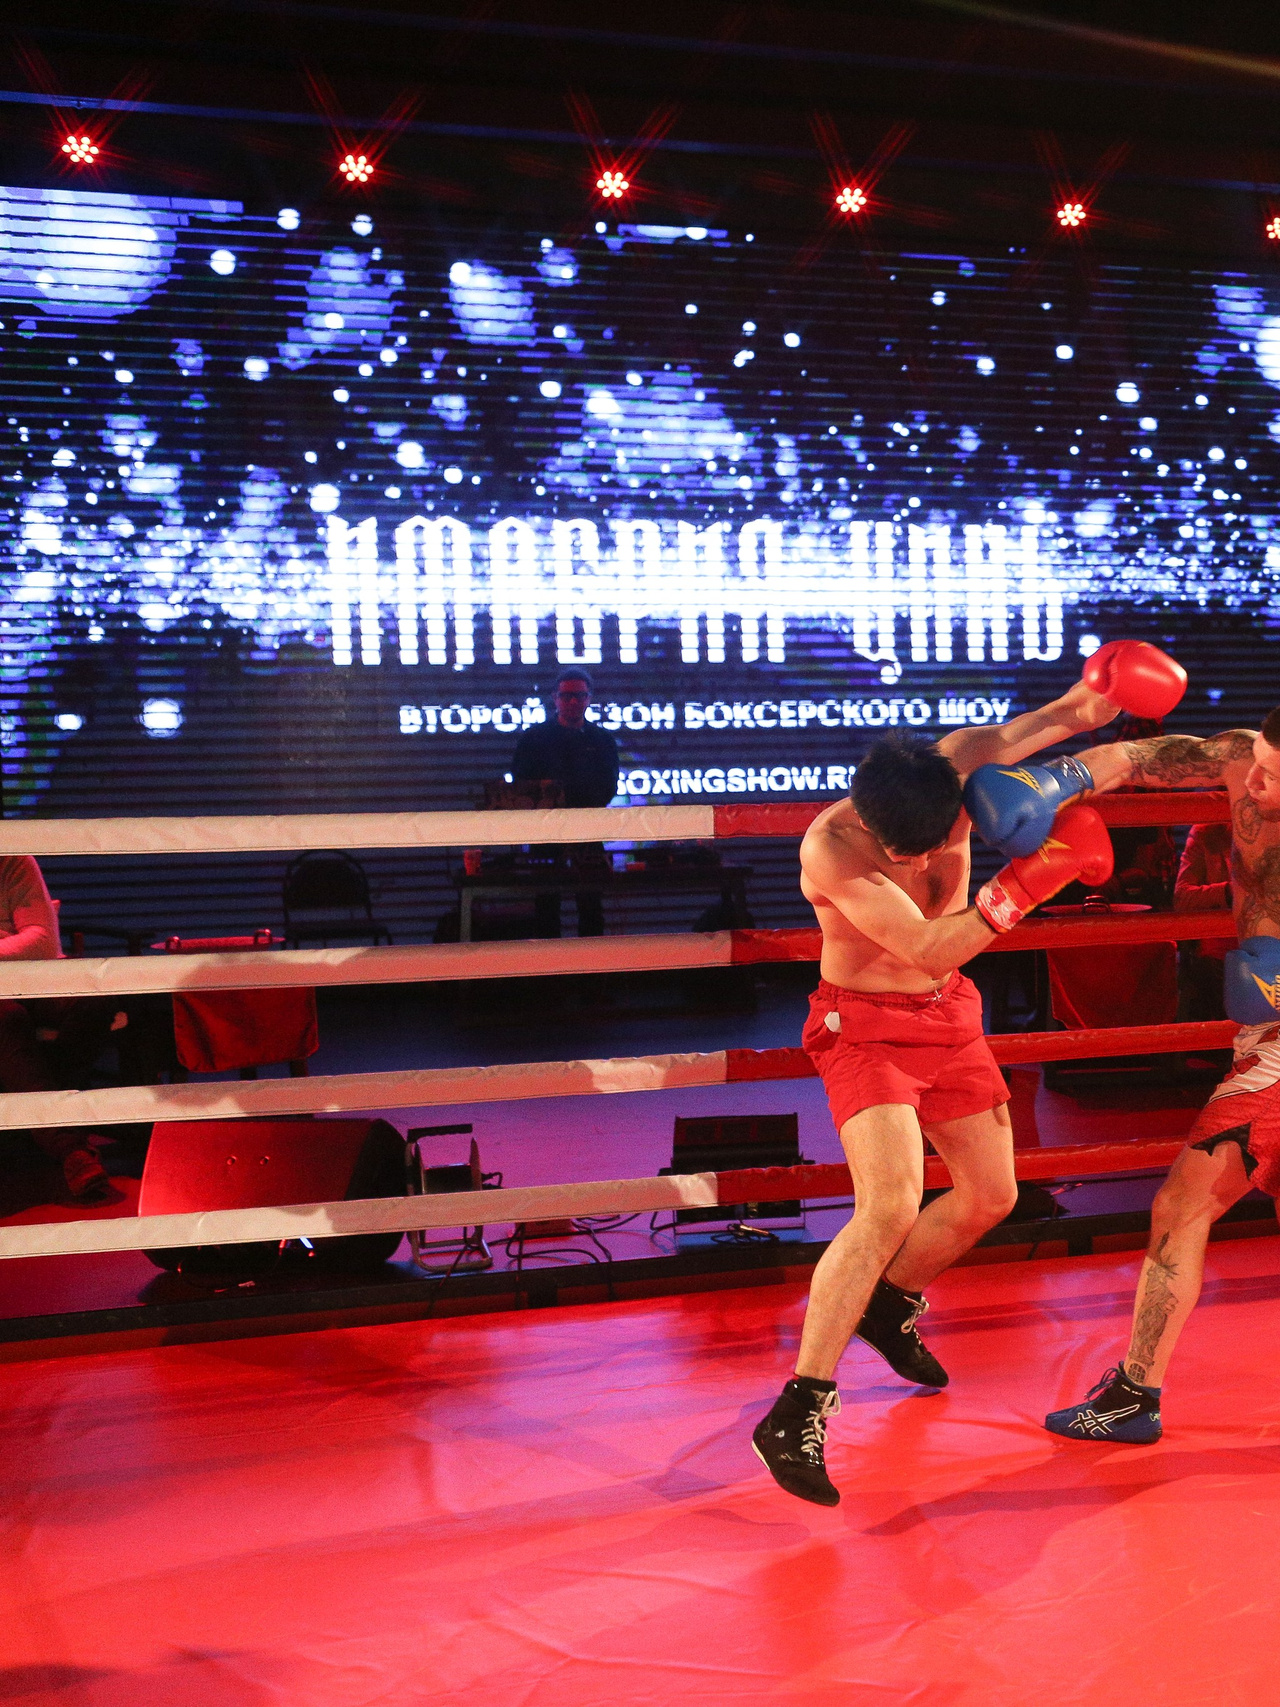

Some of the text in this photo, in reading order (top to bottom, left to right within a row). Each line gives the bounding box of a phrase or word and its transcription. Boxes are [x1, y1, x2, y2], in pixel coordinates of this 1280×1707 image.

[399, 697, 1011, 734] ВТОРОЙ ЕЗОН БОКСЕРСКОГО ШОУ
